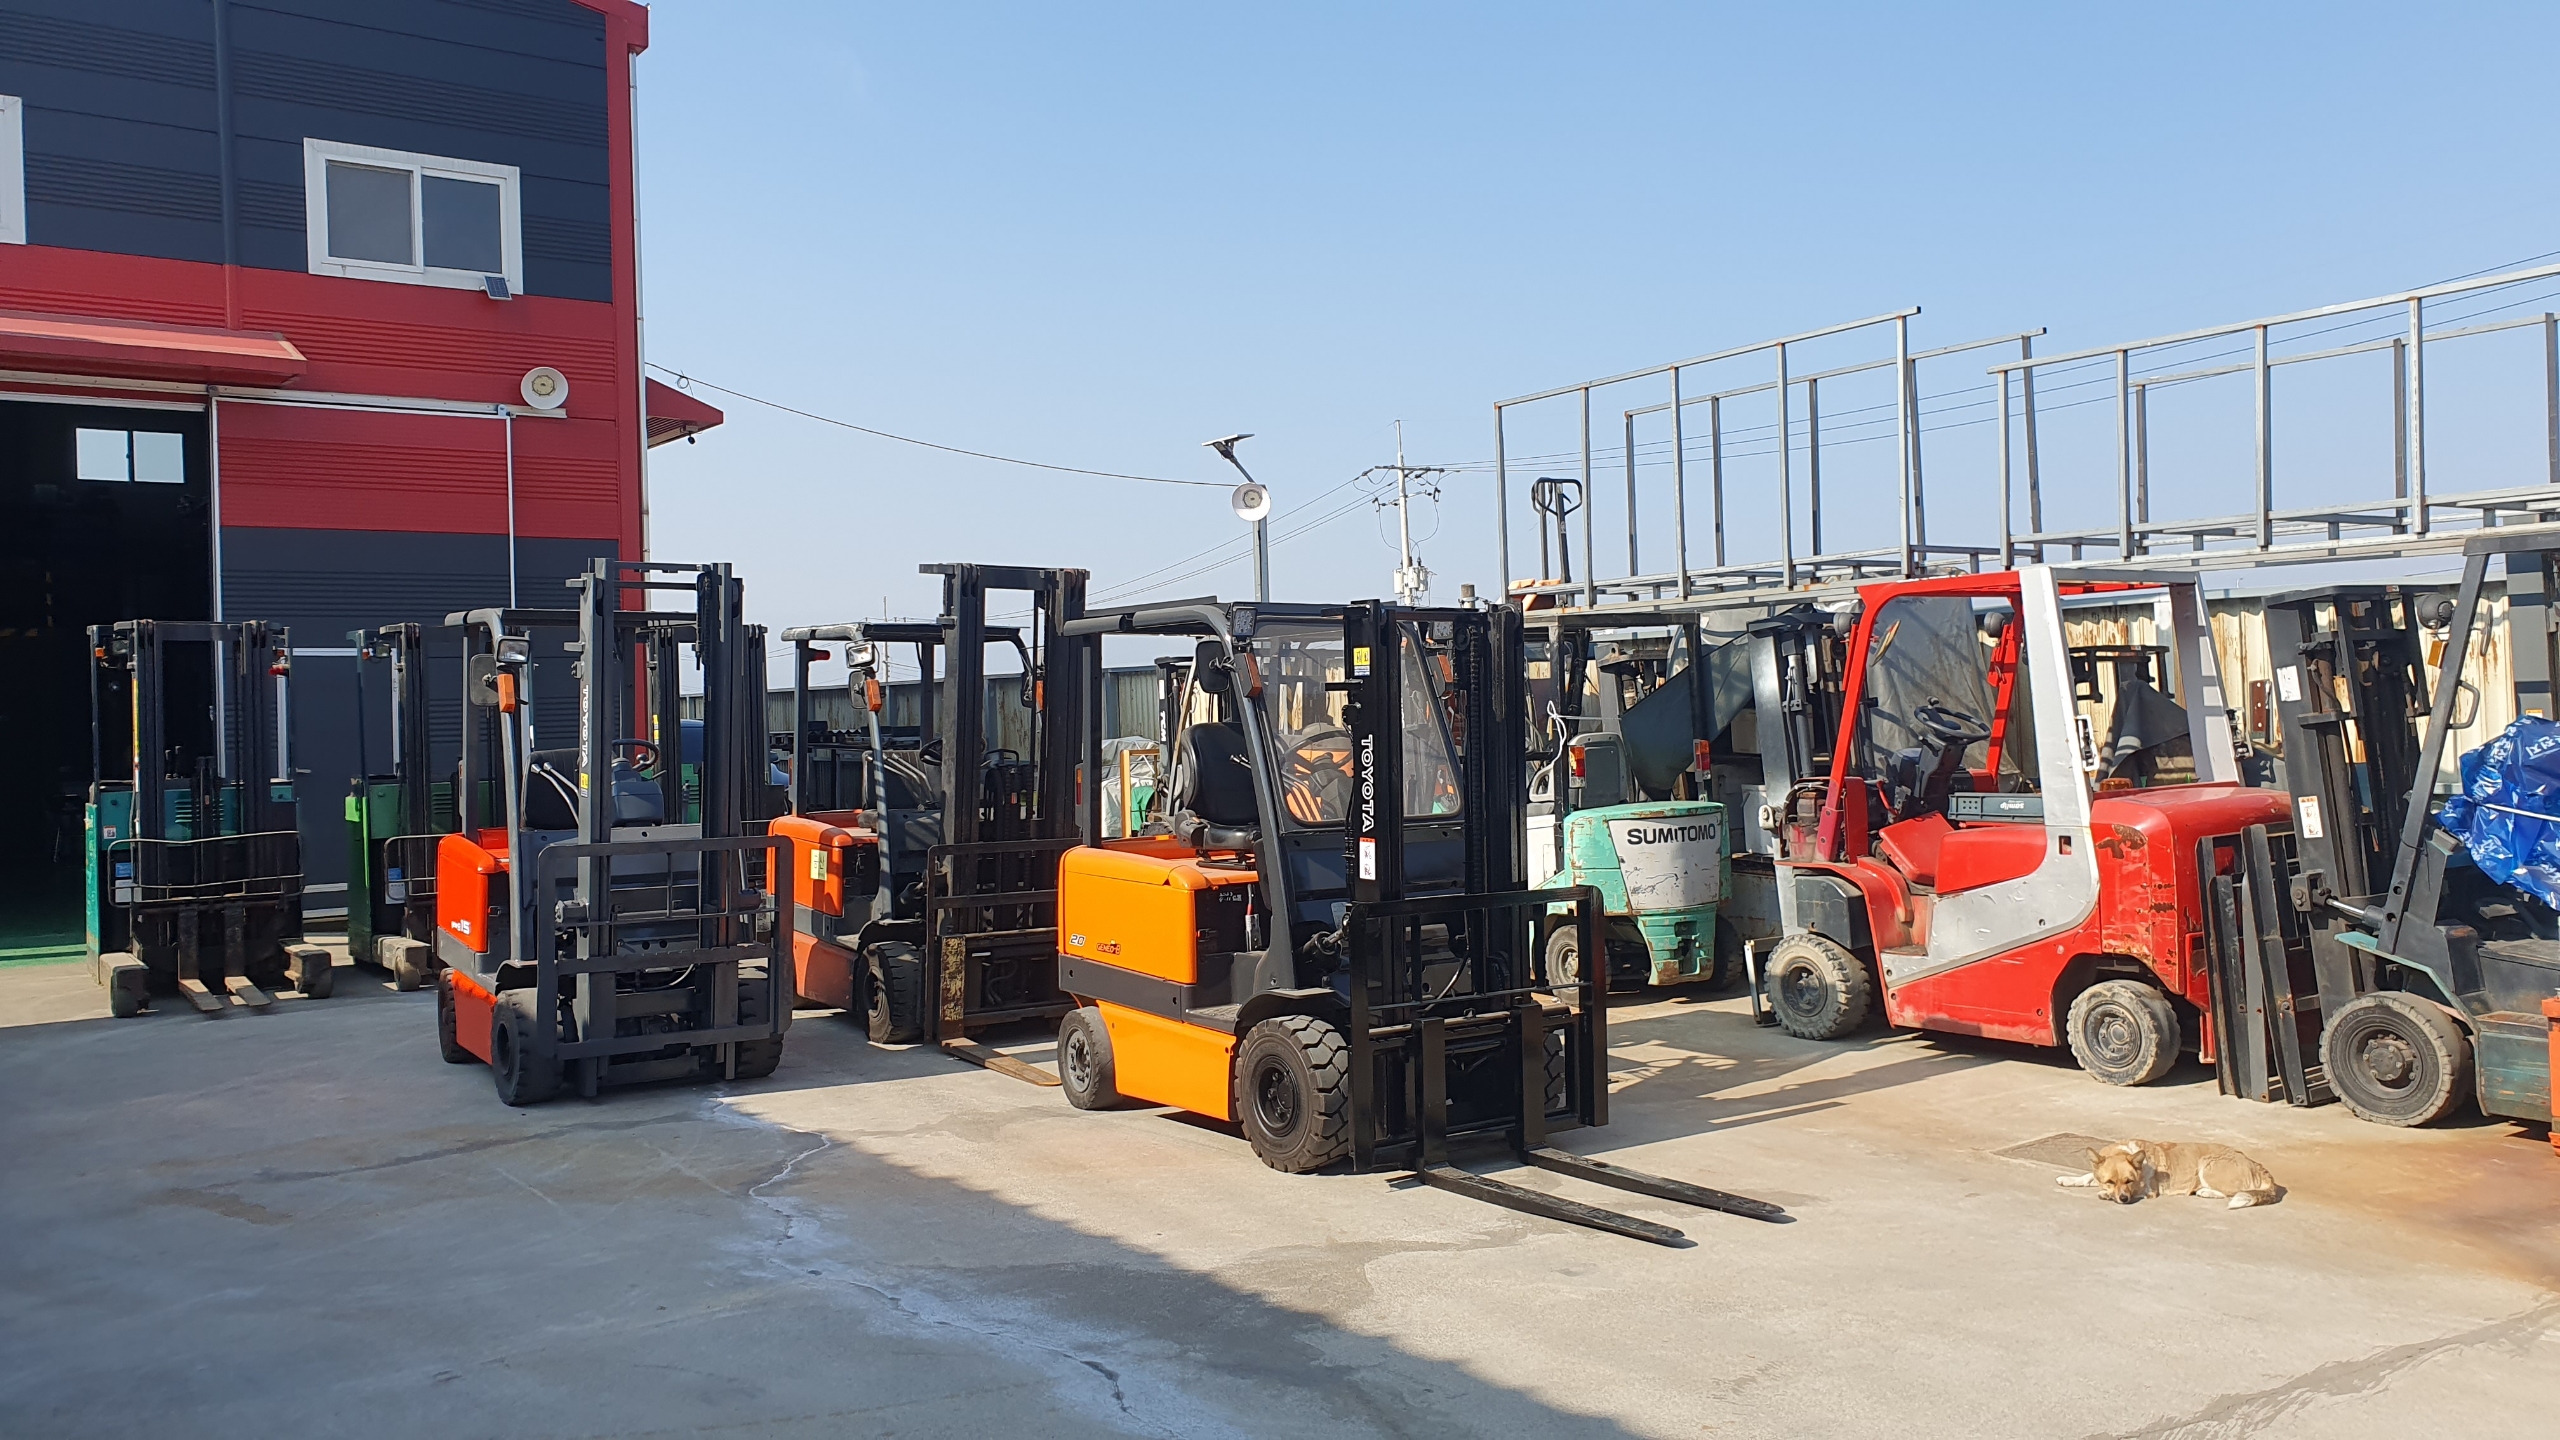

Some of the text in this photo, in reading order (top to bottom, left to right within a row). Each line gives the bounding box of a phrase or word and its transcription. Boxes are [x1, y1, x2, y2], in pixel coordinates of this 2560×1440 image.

[1361, 733, 1375, 833] TOYOTA
[1626, 822, 1717, 846] SUMITOMO
[1069, 933, 1086, 947] 20
